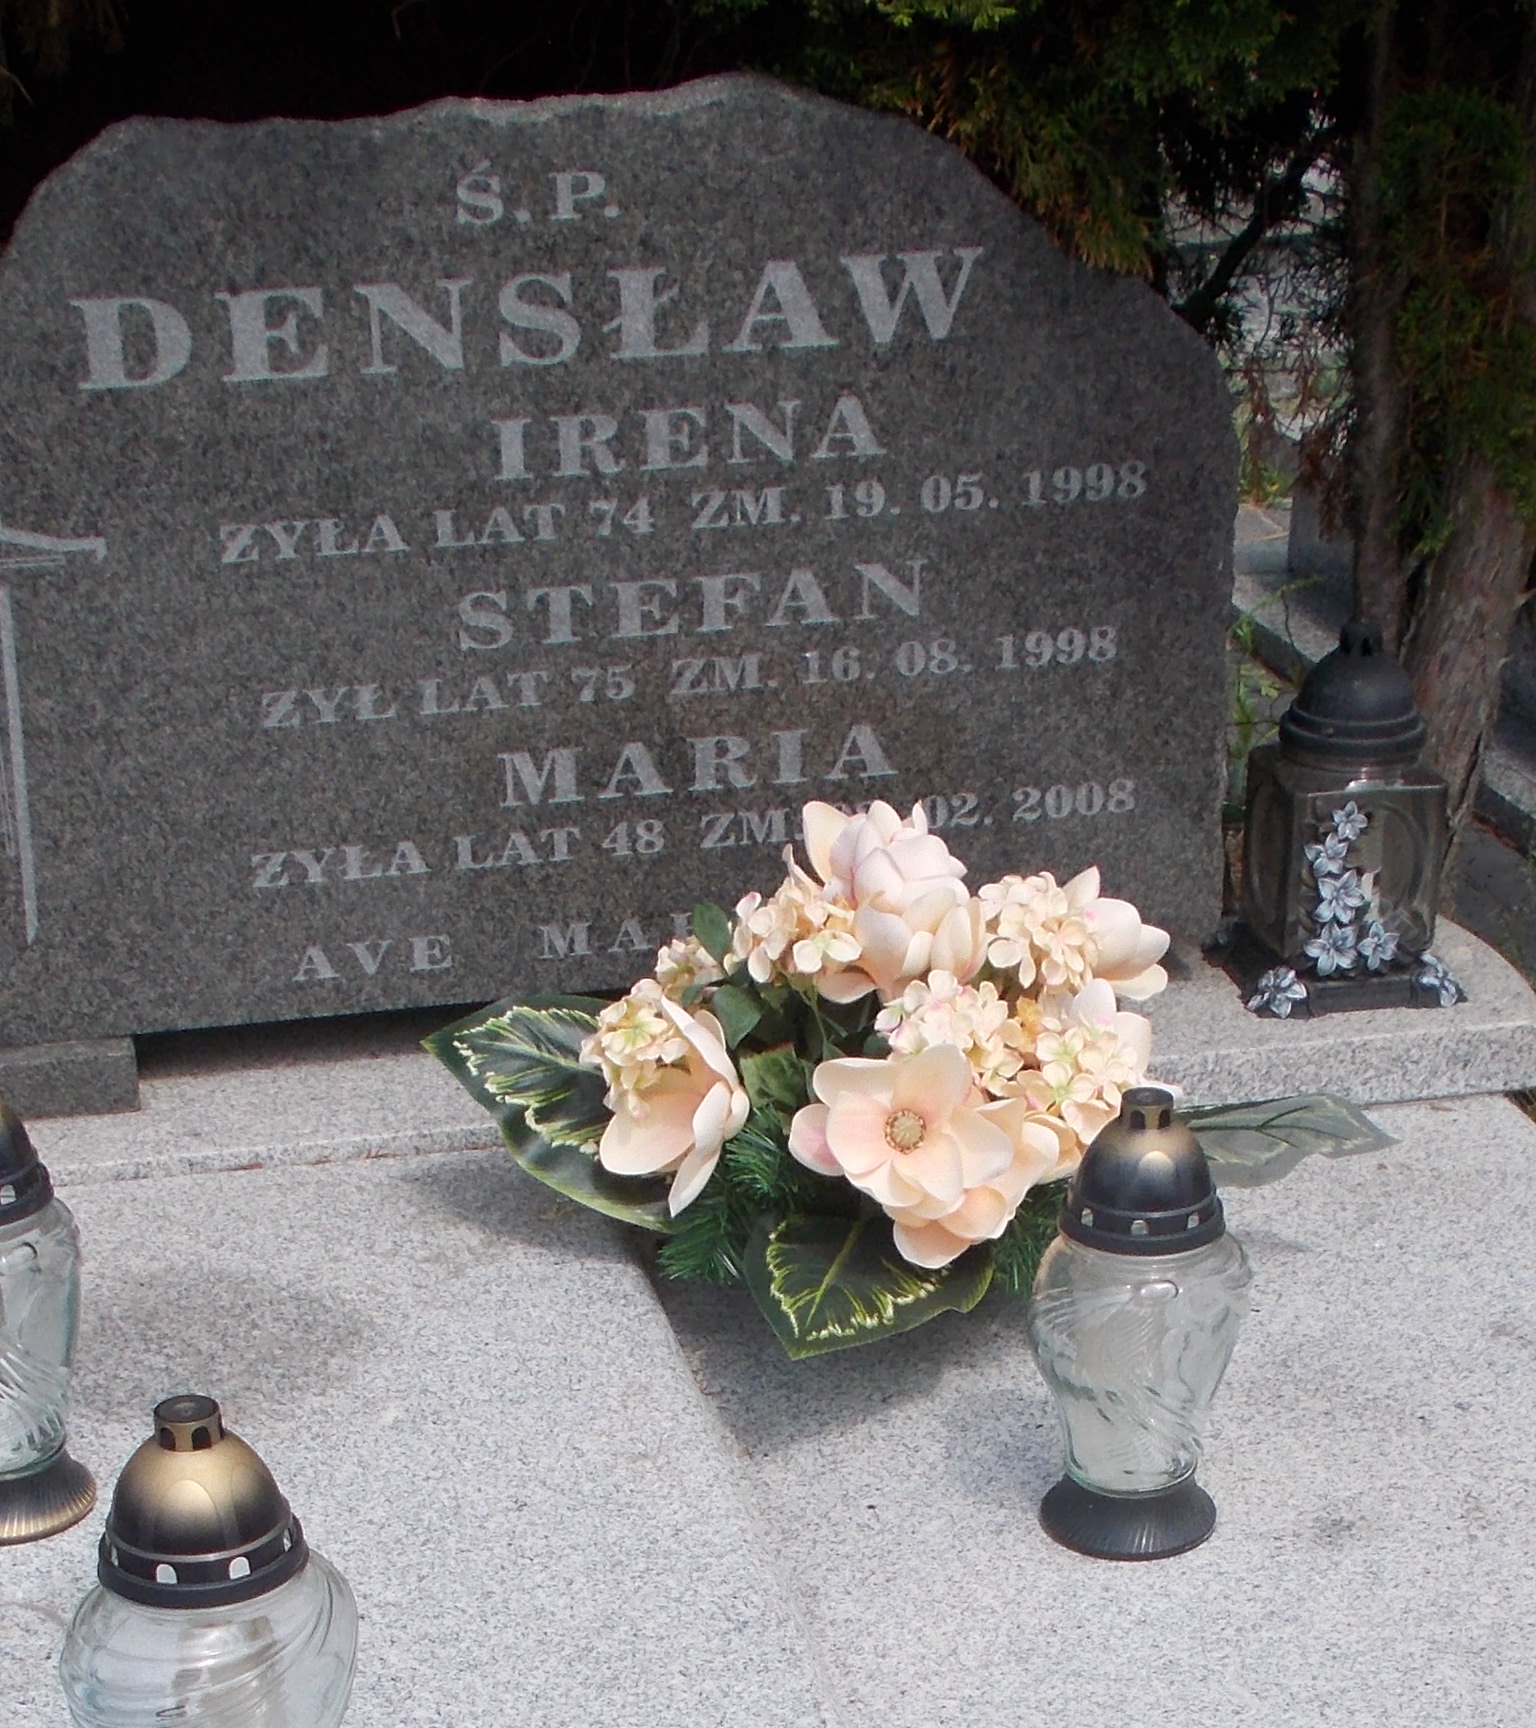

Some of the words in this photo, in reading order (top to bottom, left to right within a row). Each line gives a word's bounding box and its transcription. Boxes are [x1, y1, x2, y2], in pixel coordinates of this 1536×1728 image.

[69, 245, 984, 391] DENSŁAW
[491, 395, 888, 482] IRENA
[432, 503, 565, 549] LAT
[589, 499, 654, 537] 74
[690, 486, 802, 529] ZM.
[825, 482, 902, 520] 19.
[920, 474, 1000, 513] 05.
[1021, 460, 1148, 507] 1998
[457, 560, 927, 652] STEFAN
[417, 670, 550, 716] LAT
[570, 664, 638, 702] 75
[669, 654, 779, 695] ZM.
[799, 646, 876, 685] 16.
[894, 638, 972, 677] 08.
[995, 625, 1118, 670] 1998
[497, 722, 899, 808] MARIA
[453, 827, 581, 870] LAT
[601, 819, 664, 856] 48
[1013, 778, 1136, 822] 2008
[293, 935, 453, 981] AVE
